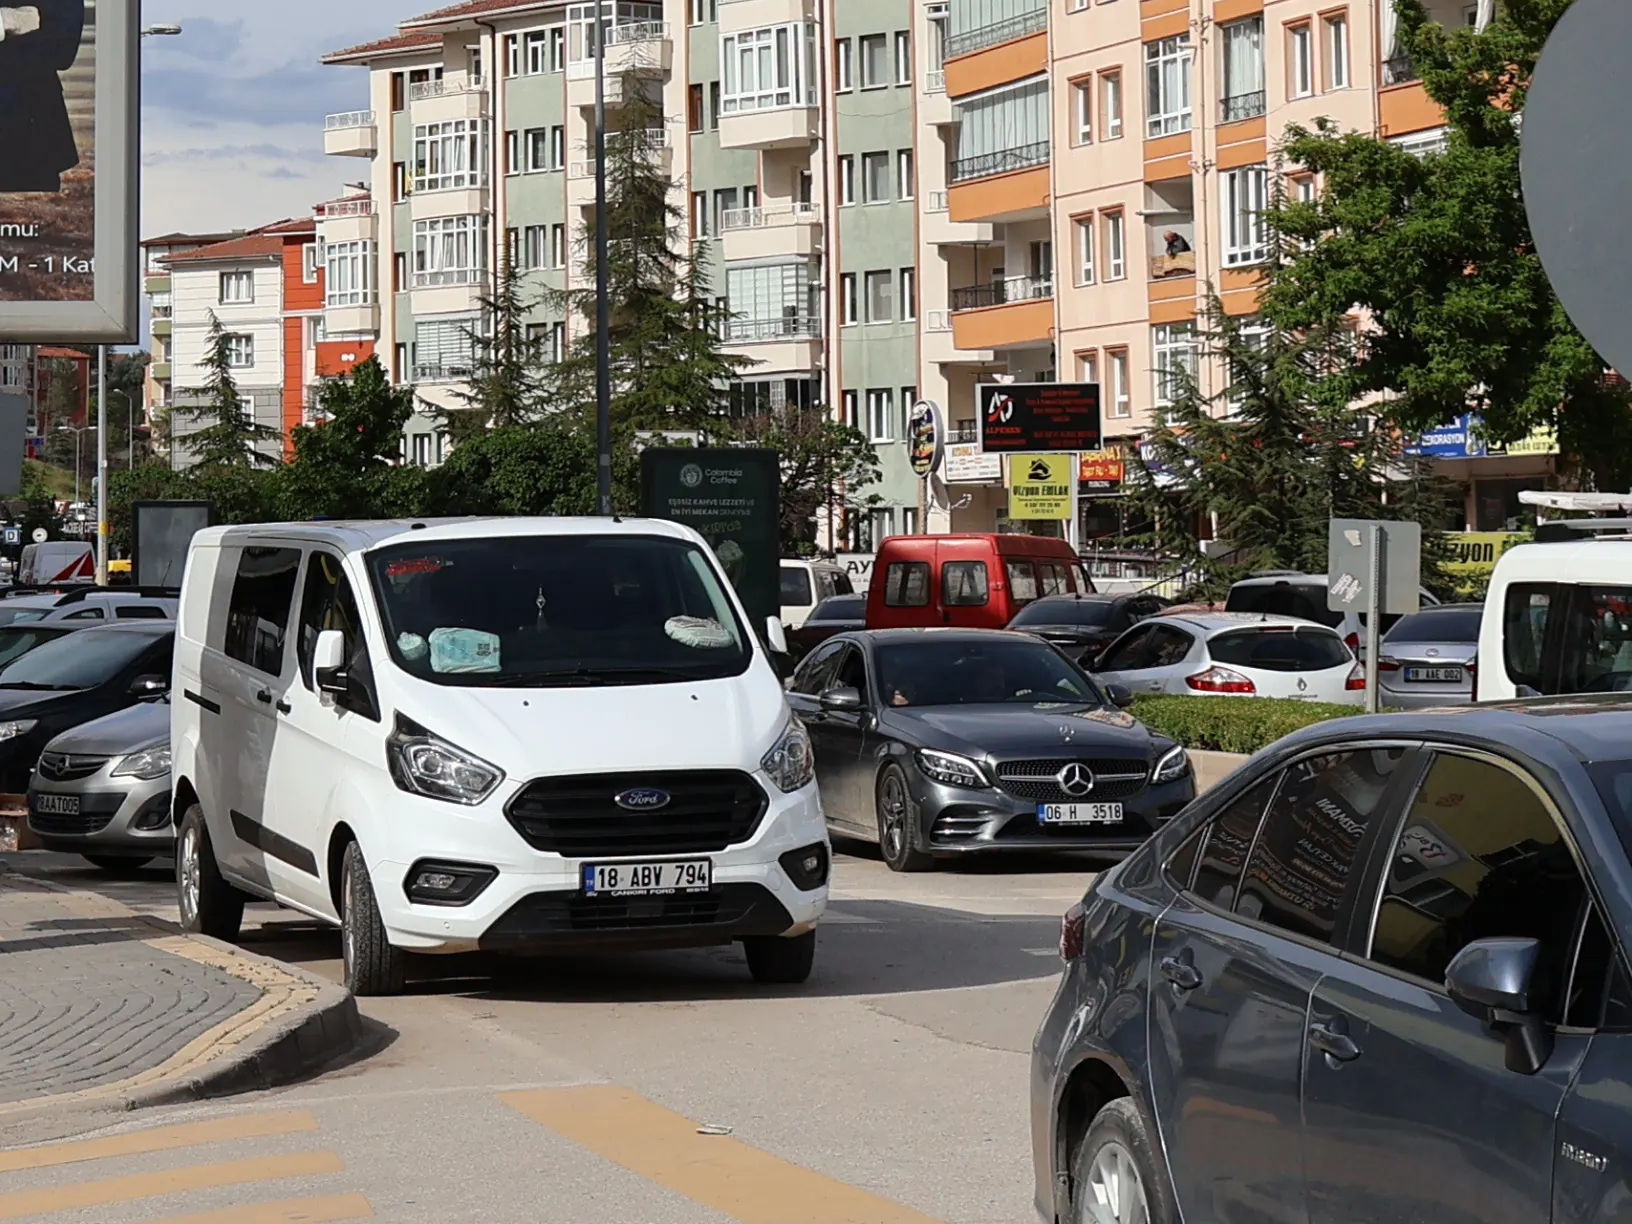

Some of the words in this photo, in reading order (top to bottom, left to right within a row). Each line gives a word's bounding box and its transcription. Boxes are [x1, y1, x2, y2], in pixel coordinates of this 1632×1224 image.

[44, 257, 54, 273] 1
[710, 476, 738, 485] Coffee
[628, 791, 659, 805] Ford
[1046, 805, 1062, 820] 06
[1069, 804, 1078, 820] H
[1092, 804, 1121, 819] 3518
[598, 868, 619, 889] 18
[630, 865, 663, 887] ABV
[675, 864, 707, 885] 794
